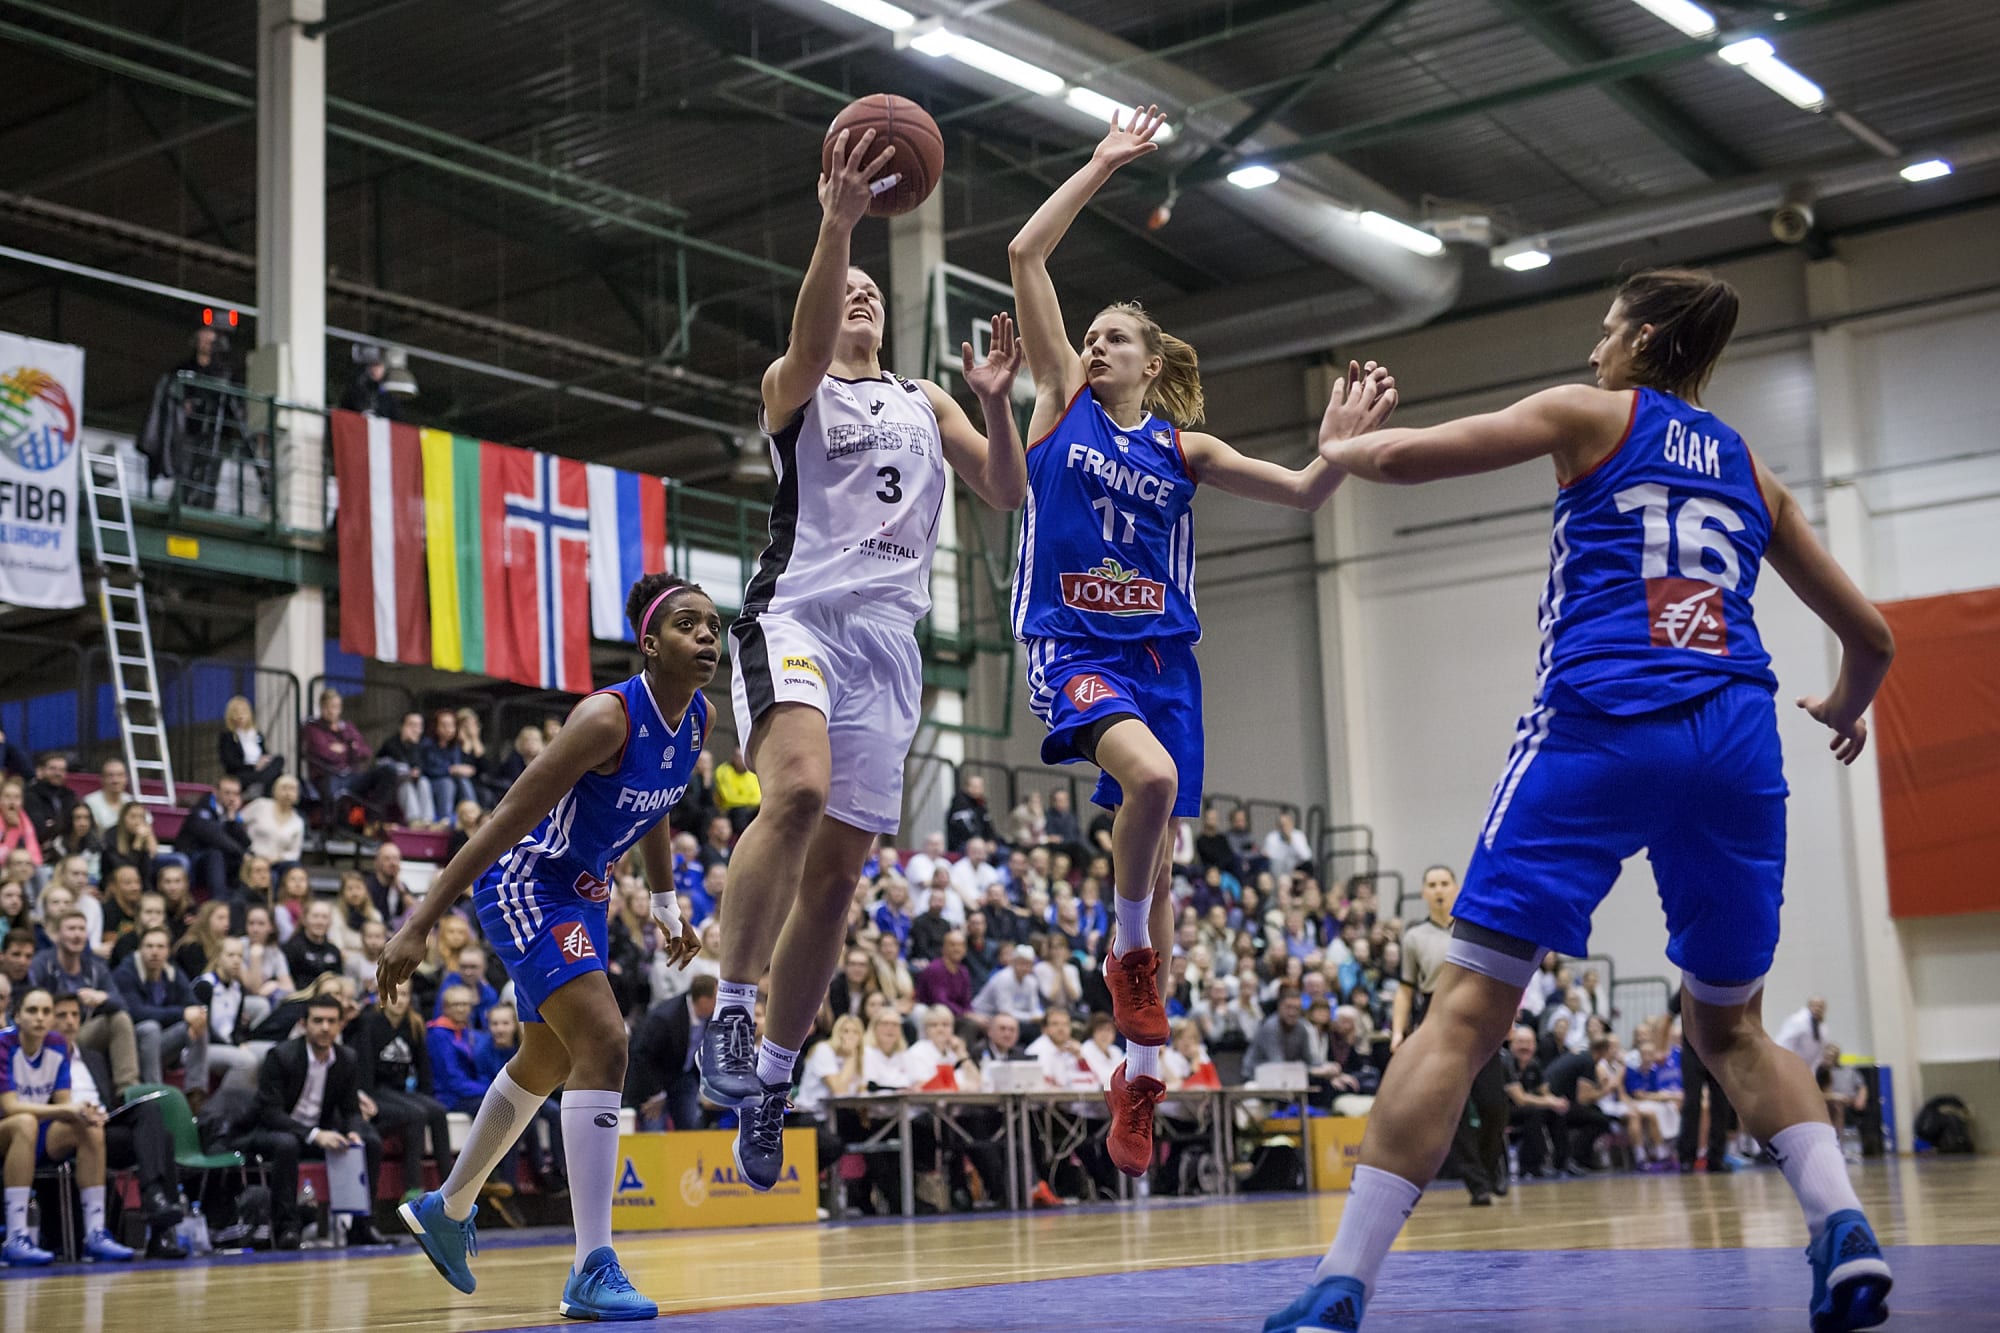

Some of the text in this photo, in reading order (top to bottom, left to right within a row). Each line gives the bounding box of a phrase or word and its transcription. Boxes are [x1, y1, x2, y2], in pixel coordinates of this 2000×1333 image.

[1663, 418, 1720, 478] CIAK
[876, 466, 903, 504] 3
[1066, 443, 1175, 508] FRANCE
[0, 480, 66, 524] FIBA
[877, 540, 920, 560] METALL
[1613, 482, 1746, 592] 16
[1069, 581, 1160, 608] JOKER
